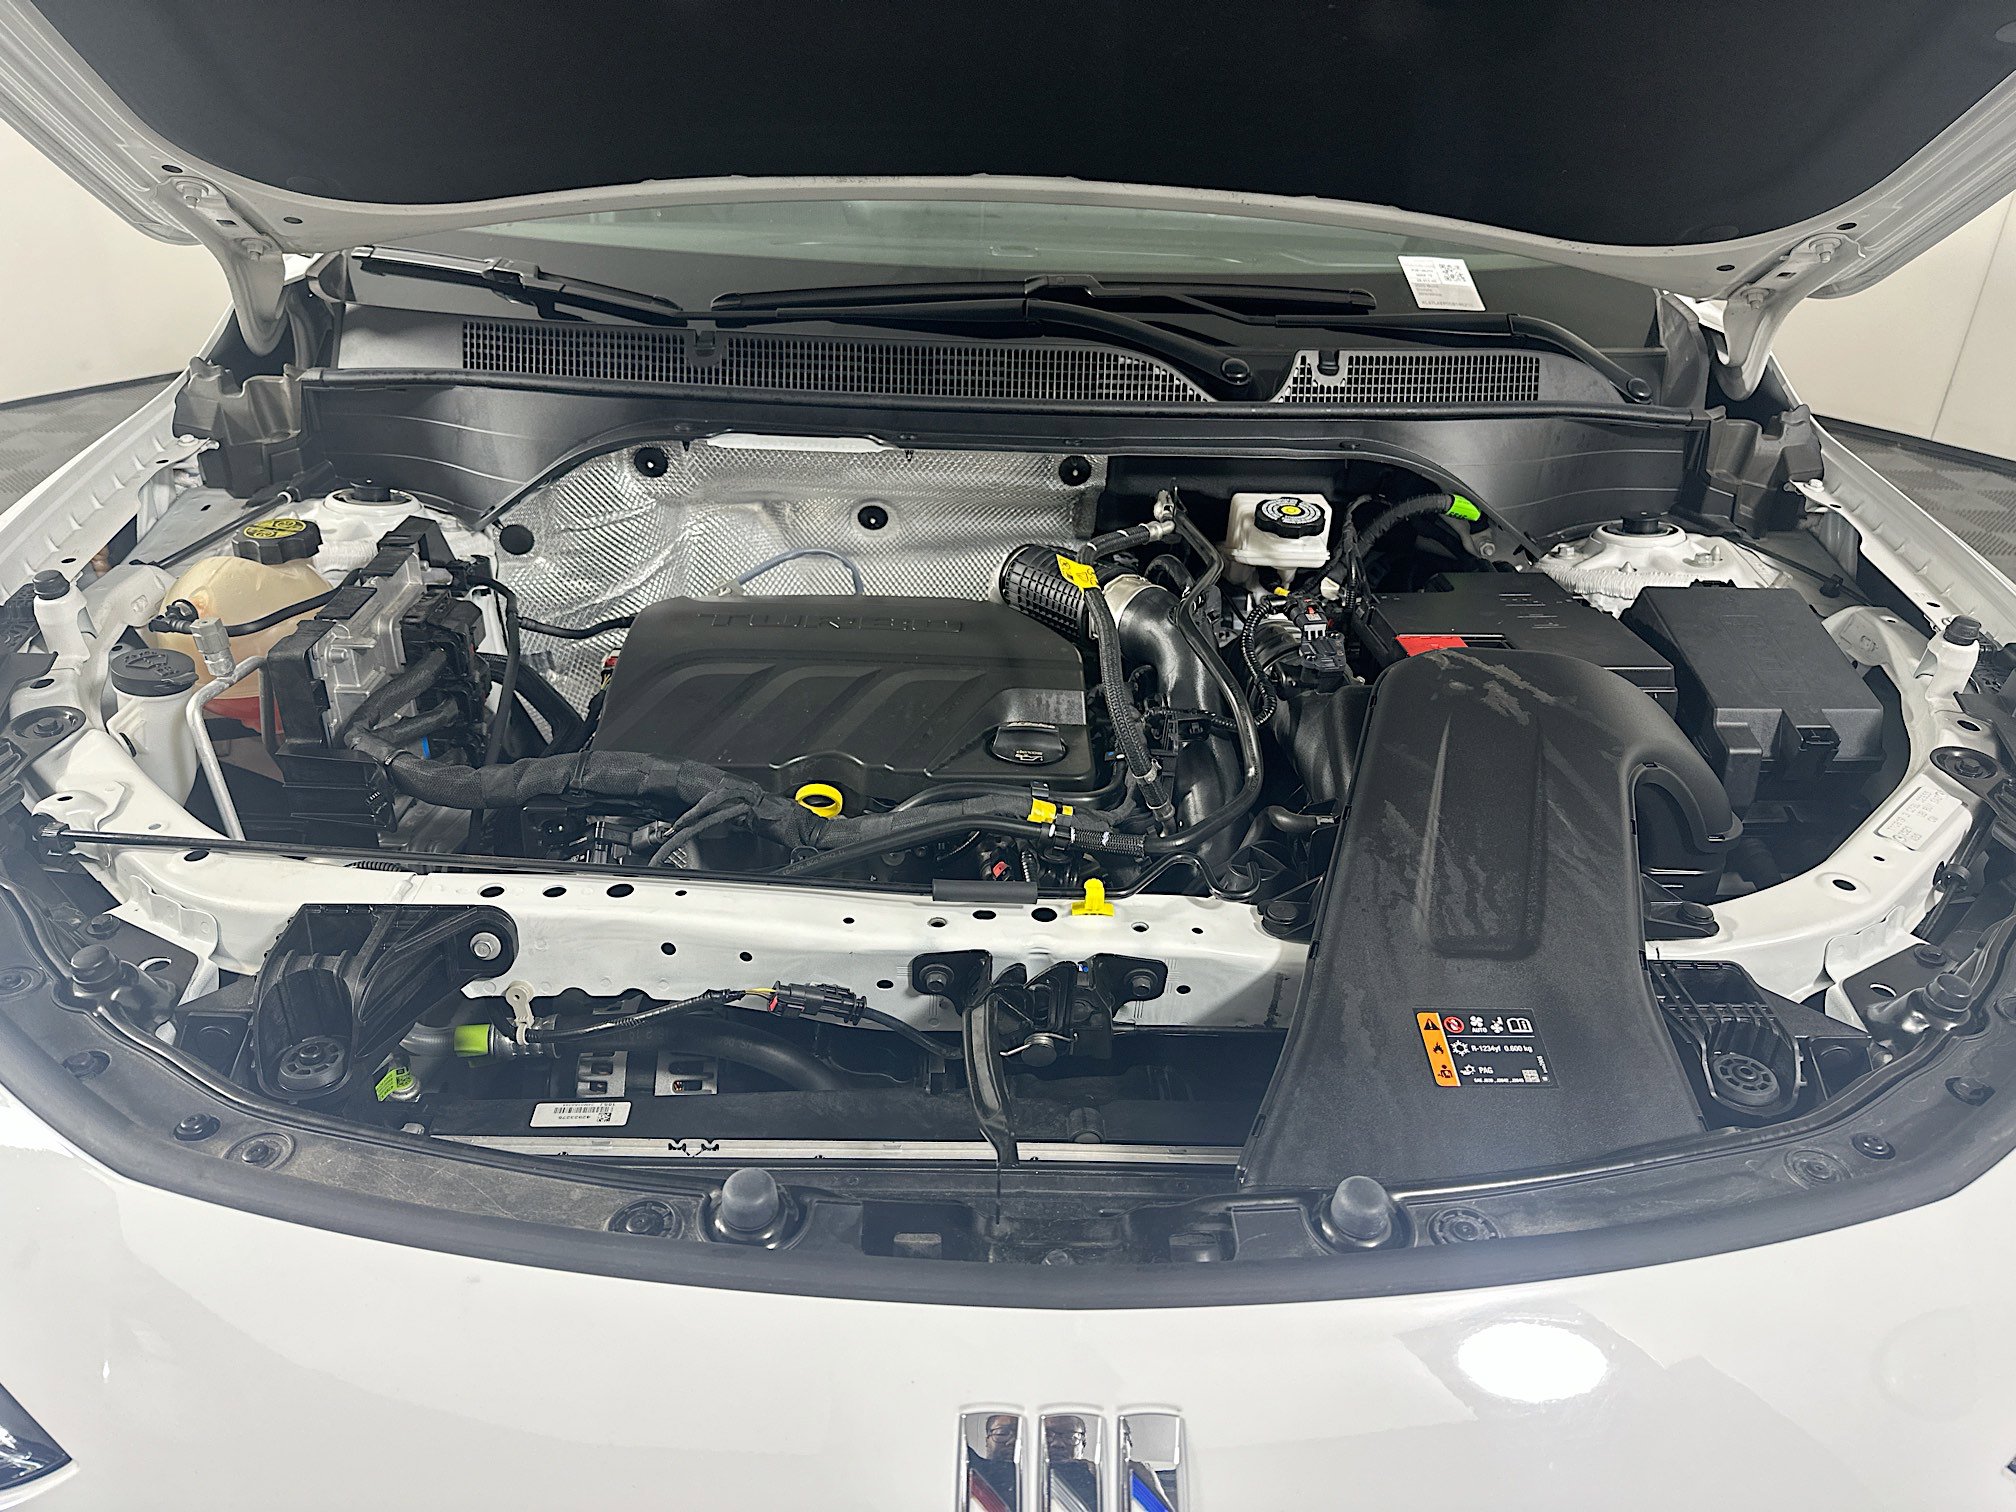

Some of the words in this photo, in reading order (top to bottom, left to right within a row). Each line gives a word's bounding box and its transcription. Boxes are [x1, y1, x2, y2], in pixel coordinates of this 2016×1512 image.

[697, 613, 964, 634] TURBO
[1471, 1045, 1501, 1053] R-1234yf
[1524, 1045, 1533, 1053] kg
[1478, 1066, 1494, 1074] PAG
